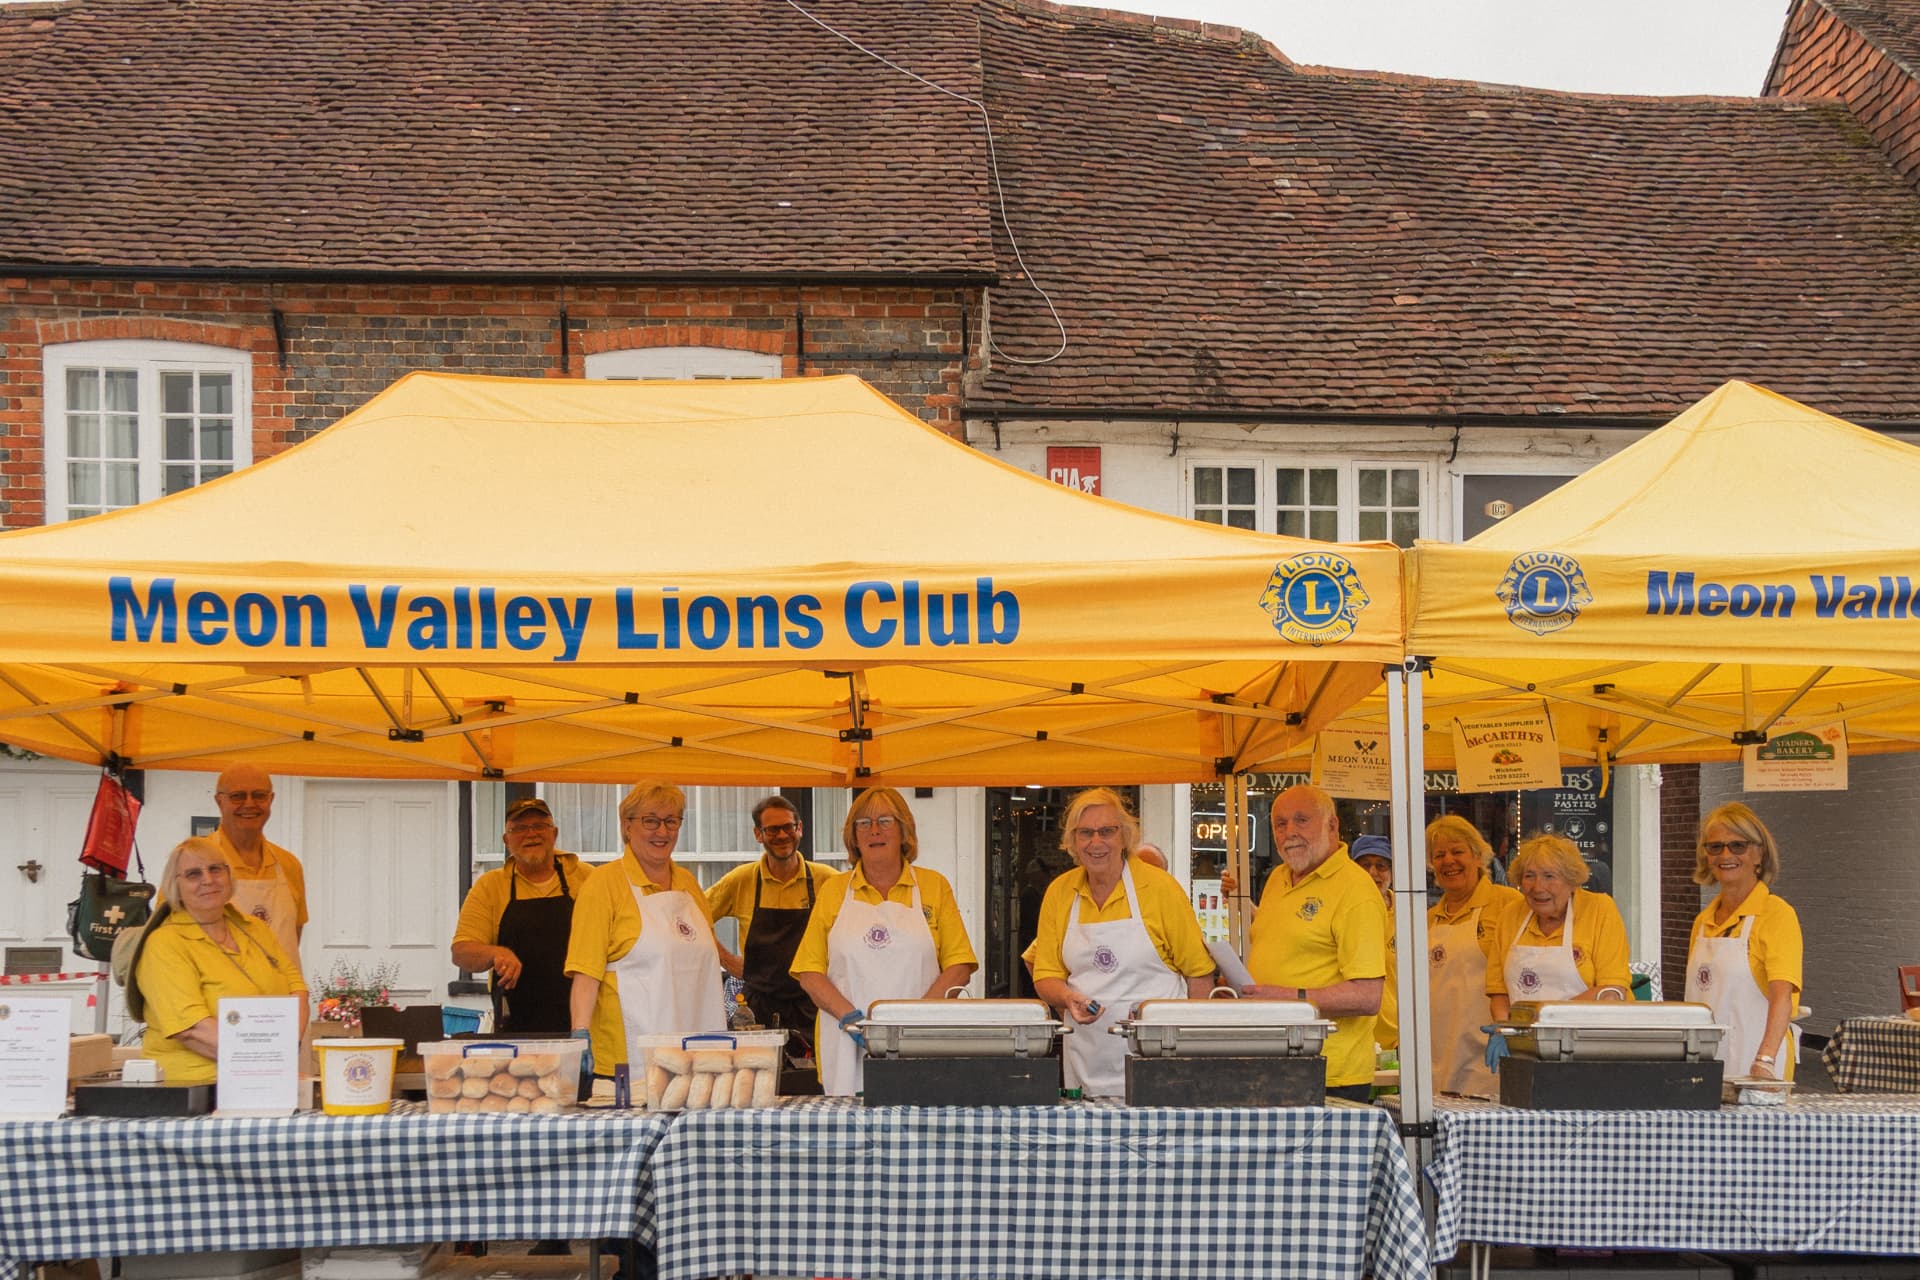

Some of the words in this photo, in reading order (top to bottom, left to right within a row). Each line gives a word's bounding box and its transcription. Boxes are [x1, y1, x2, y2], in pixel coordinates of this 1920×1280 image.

[1283, 556, 1344, 574] LIONS
[1519, 553, 1574, 572] LIONS
[1303, 581, 1331, 615] L
[1533, 576, 1558, 607] L
[1646, 571, 1796, 618] Meon
[108, 576, 328, 647] Meon
[348, 583, 592, 663] Valley
[616, 586, 824, 651] Lions
[844, 577, 1020, 649] Club
[1286, 624, 1347, 643] INTERNATIONAL
[1464, 721, 1502, 730] VEGETABLES
[1504, 720, 1534, 728] SUPPLIED
[1467, 730, 1544, 749] McCARTHYS
[1776, 739, 1815, 747] STAINERS
[1776, 746, 1813, 755] BAKERY
[1328, 755, 1357, 763] MEON
[1362, 757, 1391, 766] VALL
[90, 922, 113, 935] First
